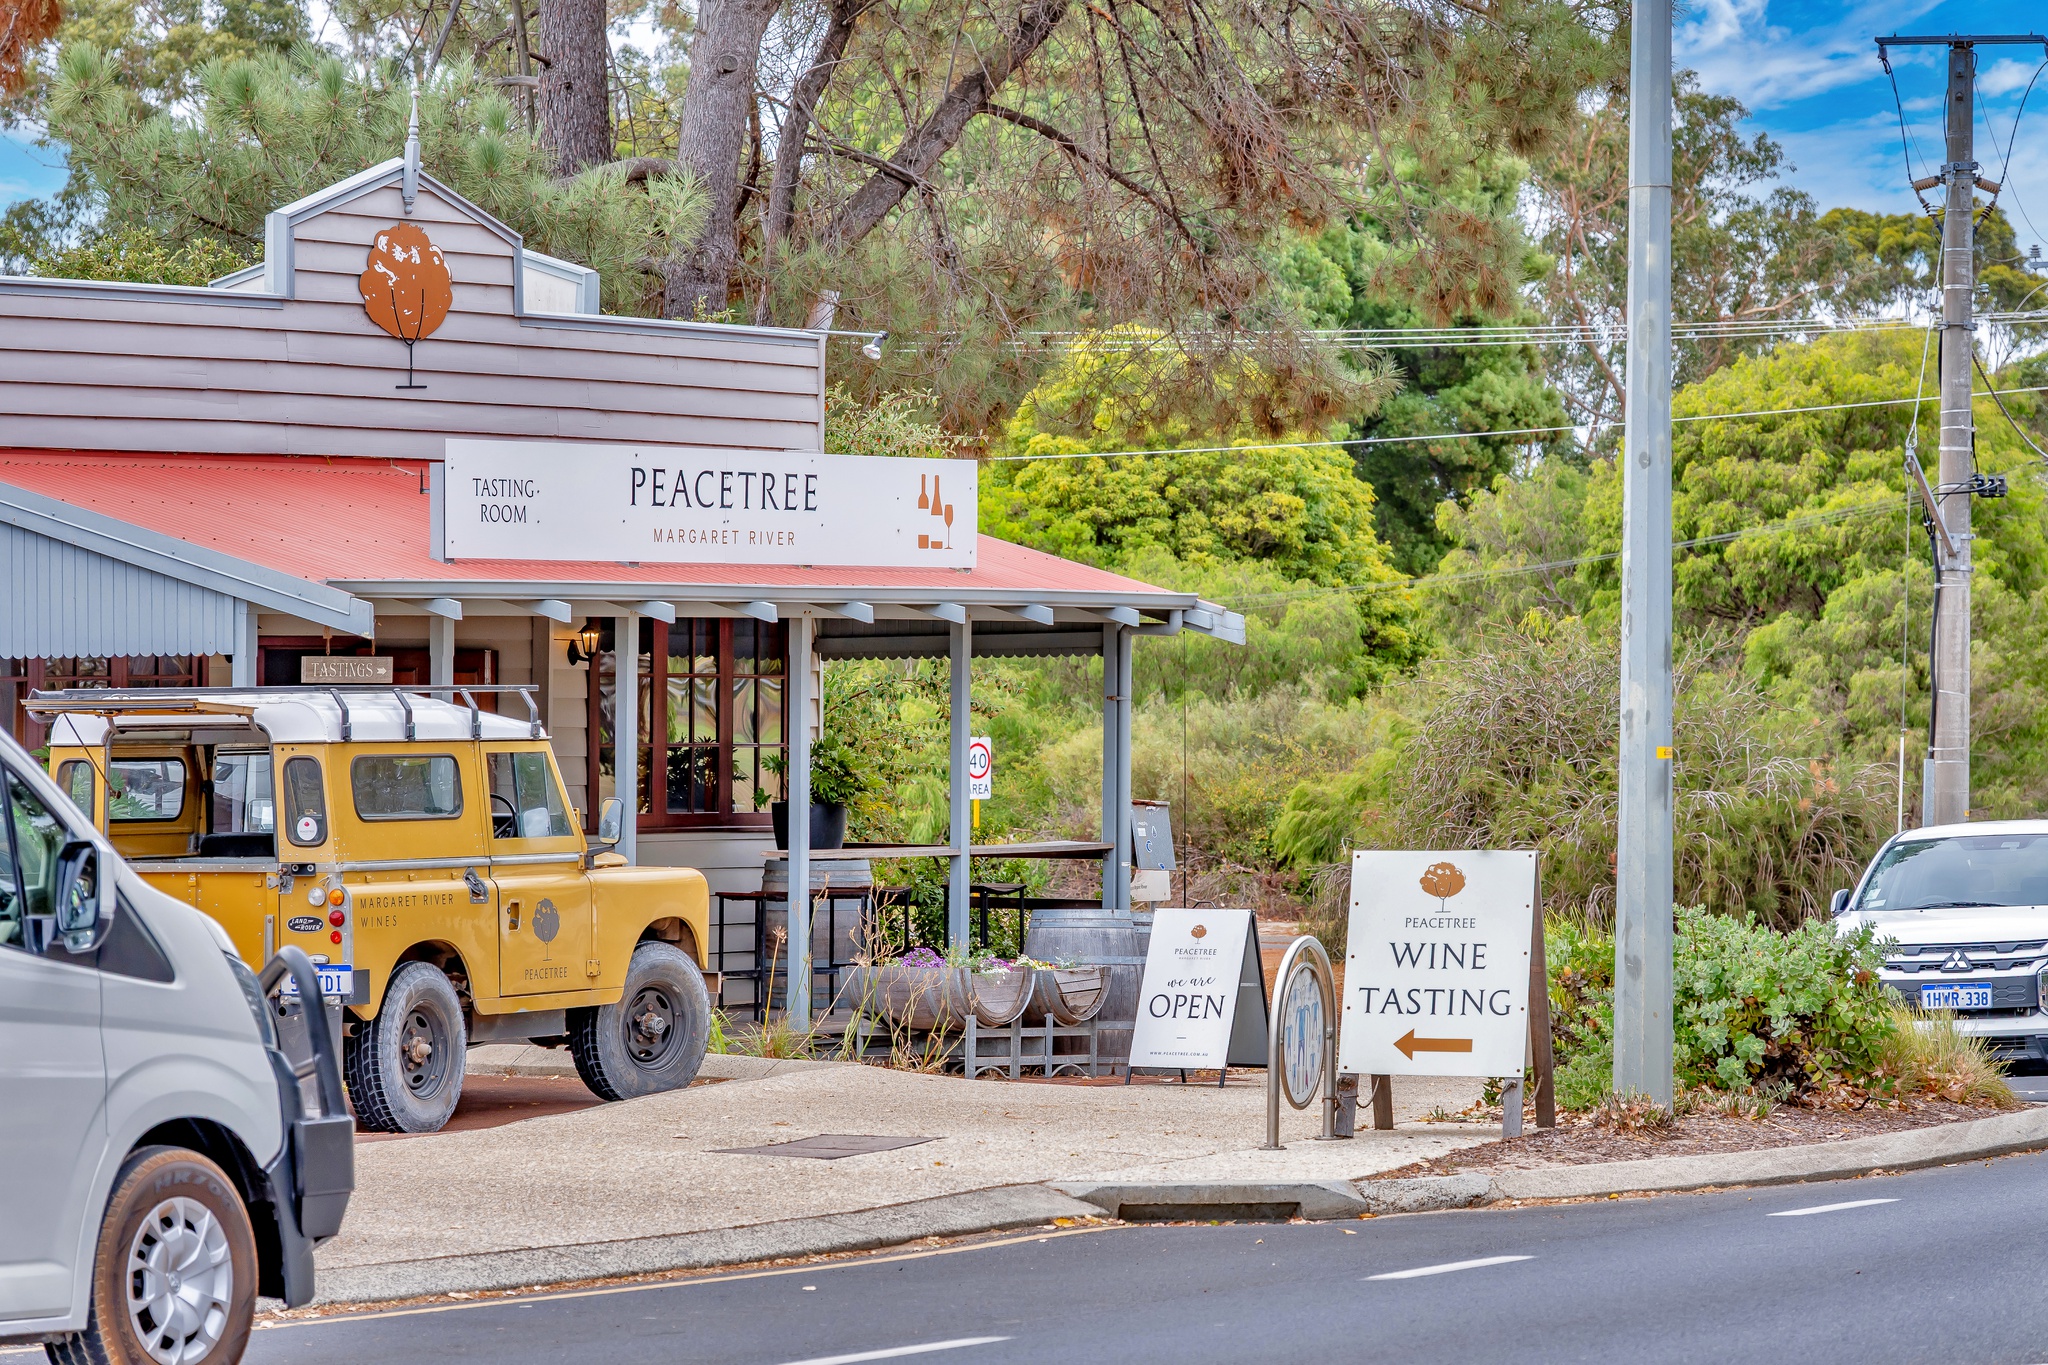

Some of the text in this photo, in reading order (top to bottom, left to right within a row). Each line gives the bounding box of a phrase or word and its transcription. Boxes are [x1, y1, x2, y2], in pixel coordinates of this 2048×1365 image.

[472, 478, 535, 498] TASTING
[630, 467, 818, 511] PEACETREE
[480, 503, 527, 523] ROOM
[653, 528, 795, 546] MARGARET RIVER
[311, 662, 374, 678] TASTINGS
[970, 753, 987, 769] 40
[970, 783, 990, 795] REA
[359, 893, 454, 909] MARGARET RIVER
[360, 915, 398, 928] WINES
[1405, 917, 1476, 929] PEACETREE
[1174, 948, 1218, 956] PEACETREE
[1388, 942, 1488, 970] WINE
[524, 966, 568, 980] PEACETREE
[1167, 976, 1217, 988] we are
[1149, 994, 1226, 1020] OPEN
[1358, 987, 1512, 1016] TASTING
